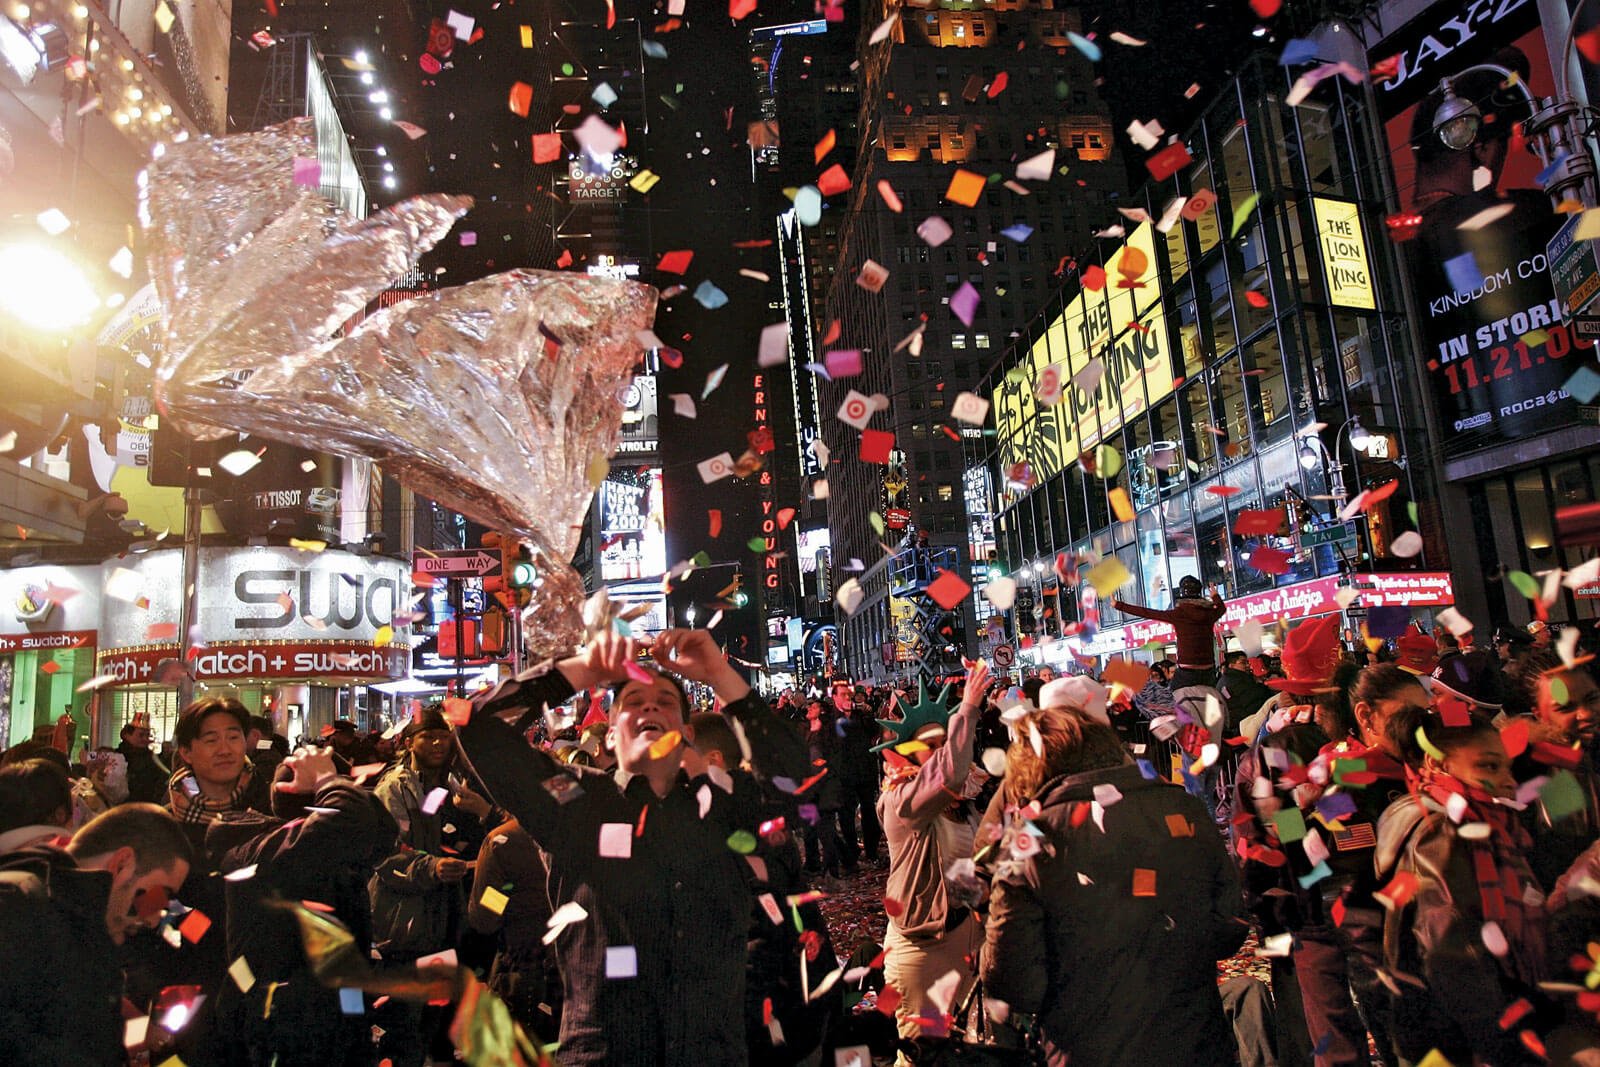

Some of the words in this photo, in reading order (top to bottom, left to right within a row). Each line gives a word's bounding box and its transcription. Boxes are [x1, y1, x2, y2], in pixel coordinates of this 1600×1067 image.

[1384, 0, 1527, 91] JAY-Z
[575, 188, 621, 198] TARGET
[1327, 220, 1352, 235] THE
[1326, 238, 1360, 262] LION
[1517, 254, 1547, 279] CO
[1331, 266, 1367, 291] KING
[1078, 301, 1109, 350] THE
[1439, 335, 1469, 363] IN
[614, 441, 658, 452] VROLET
[761, 472, 771, 485] &
[607, 482, 645, 498] HAPPY
[607, 491, 637, 505] NEW
[268, 490, 301, 507] TISSOT
[608, 502, 639, 515] YEAR
[608, 514, 646, 530] 2007
[763, 501, 778, 588] YOUNG
[1313, 534, 1318, 543] 7
[1321, 532, 1332, 540] AV
[425, 560, 449, 570] ONE
[466, 558, 491, 569] WAY
[235, 569, 408, 632] swa
[196, 650, 267, 675] atch
